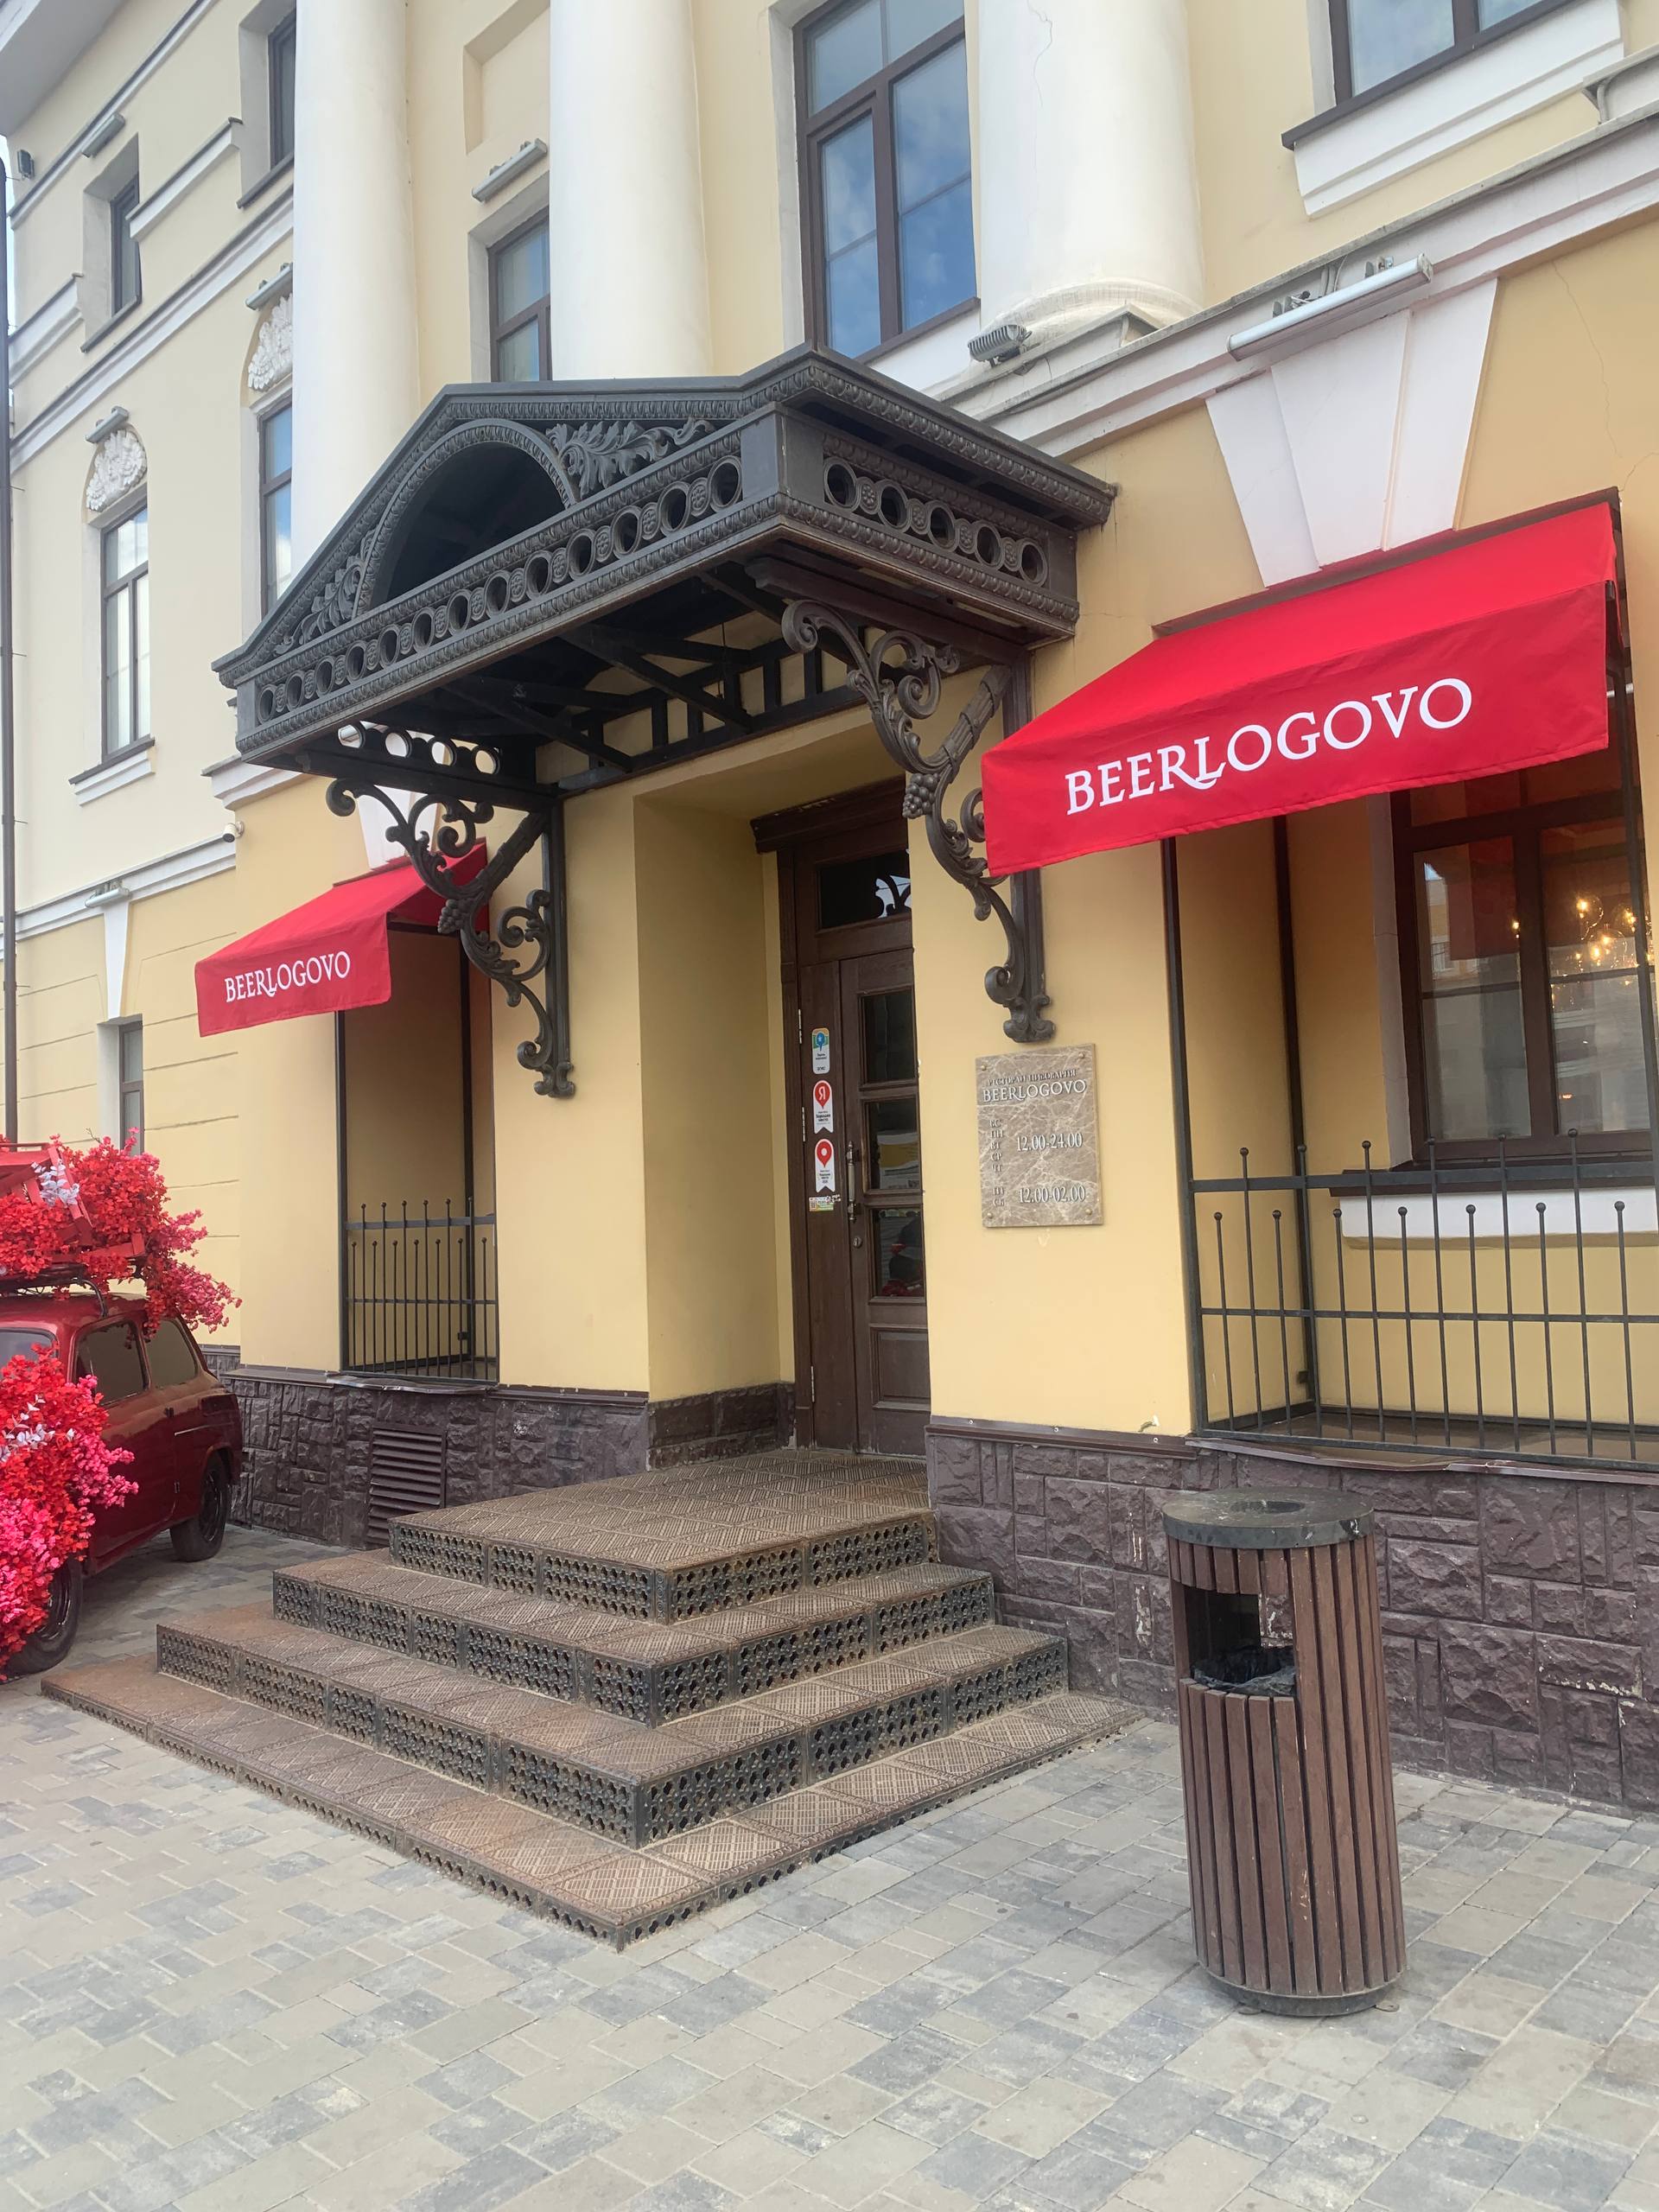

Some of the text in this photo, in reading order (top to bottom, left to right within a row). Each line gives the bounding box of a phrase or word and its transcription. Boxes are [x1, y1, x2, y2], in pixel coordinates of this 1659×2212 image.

[1065, 677, 1472, 815] BEERLOGOVO
[224, 950, 351, 1002] BEERLOGOVO
[982, 1079, 1087, 1103] BEERLOGOVO
[1016, 1132, 1084, 1152] 12.00-24.00
[1019, 1185, 1086, 1204] 12.00-02.00
